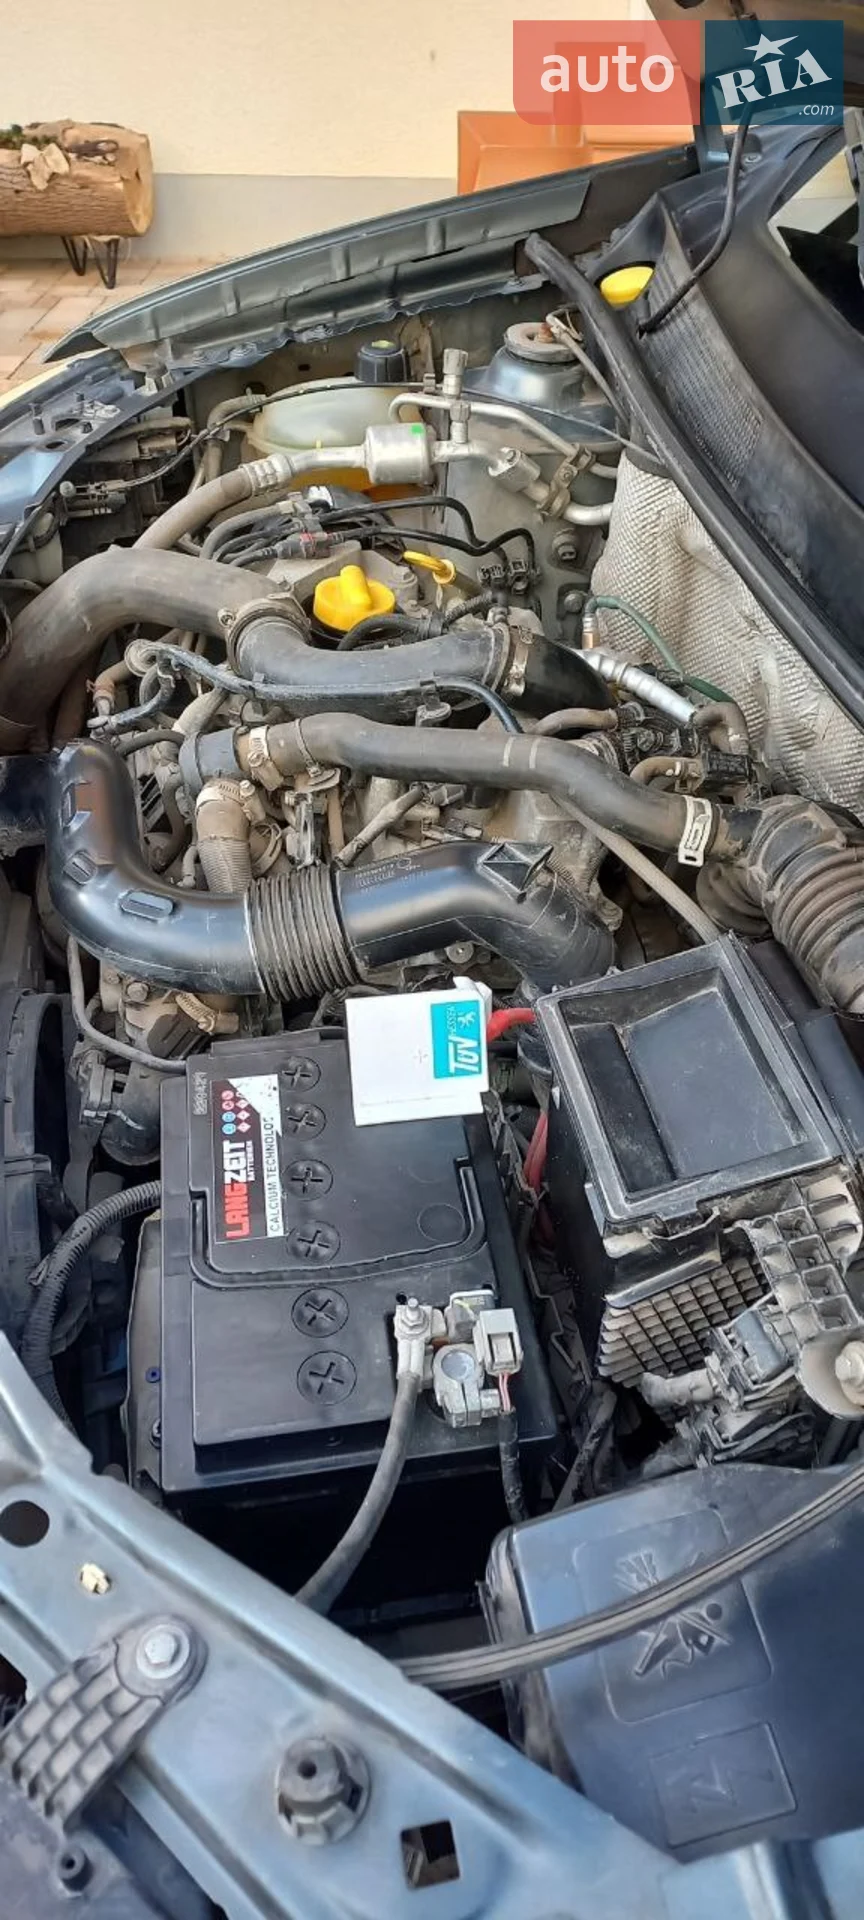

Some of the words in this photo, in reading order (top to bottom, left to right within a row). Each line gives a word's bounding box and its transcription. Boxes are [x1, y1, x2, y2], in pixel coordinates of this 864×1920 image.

[448, 1035, 480, 1075] TÜV
[222, 1139, 250, 1239] LANGZEIT
[267, 1183, 280, 1233] CALCIUM
